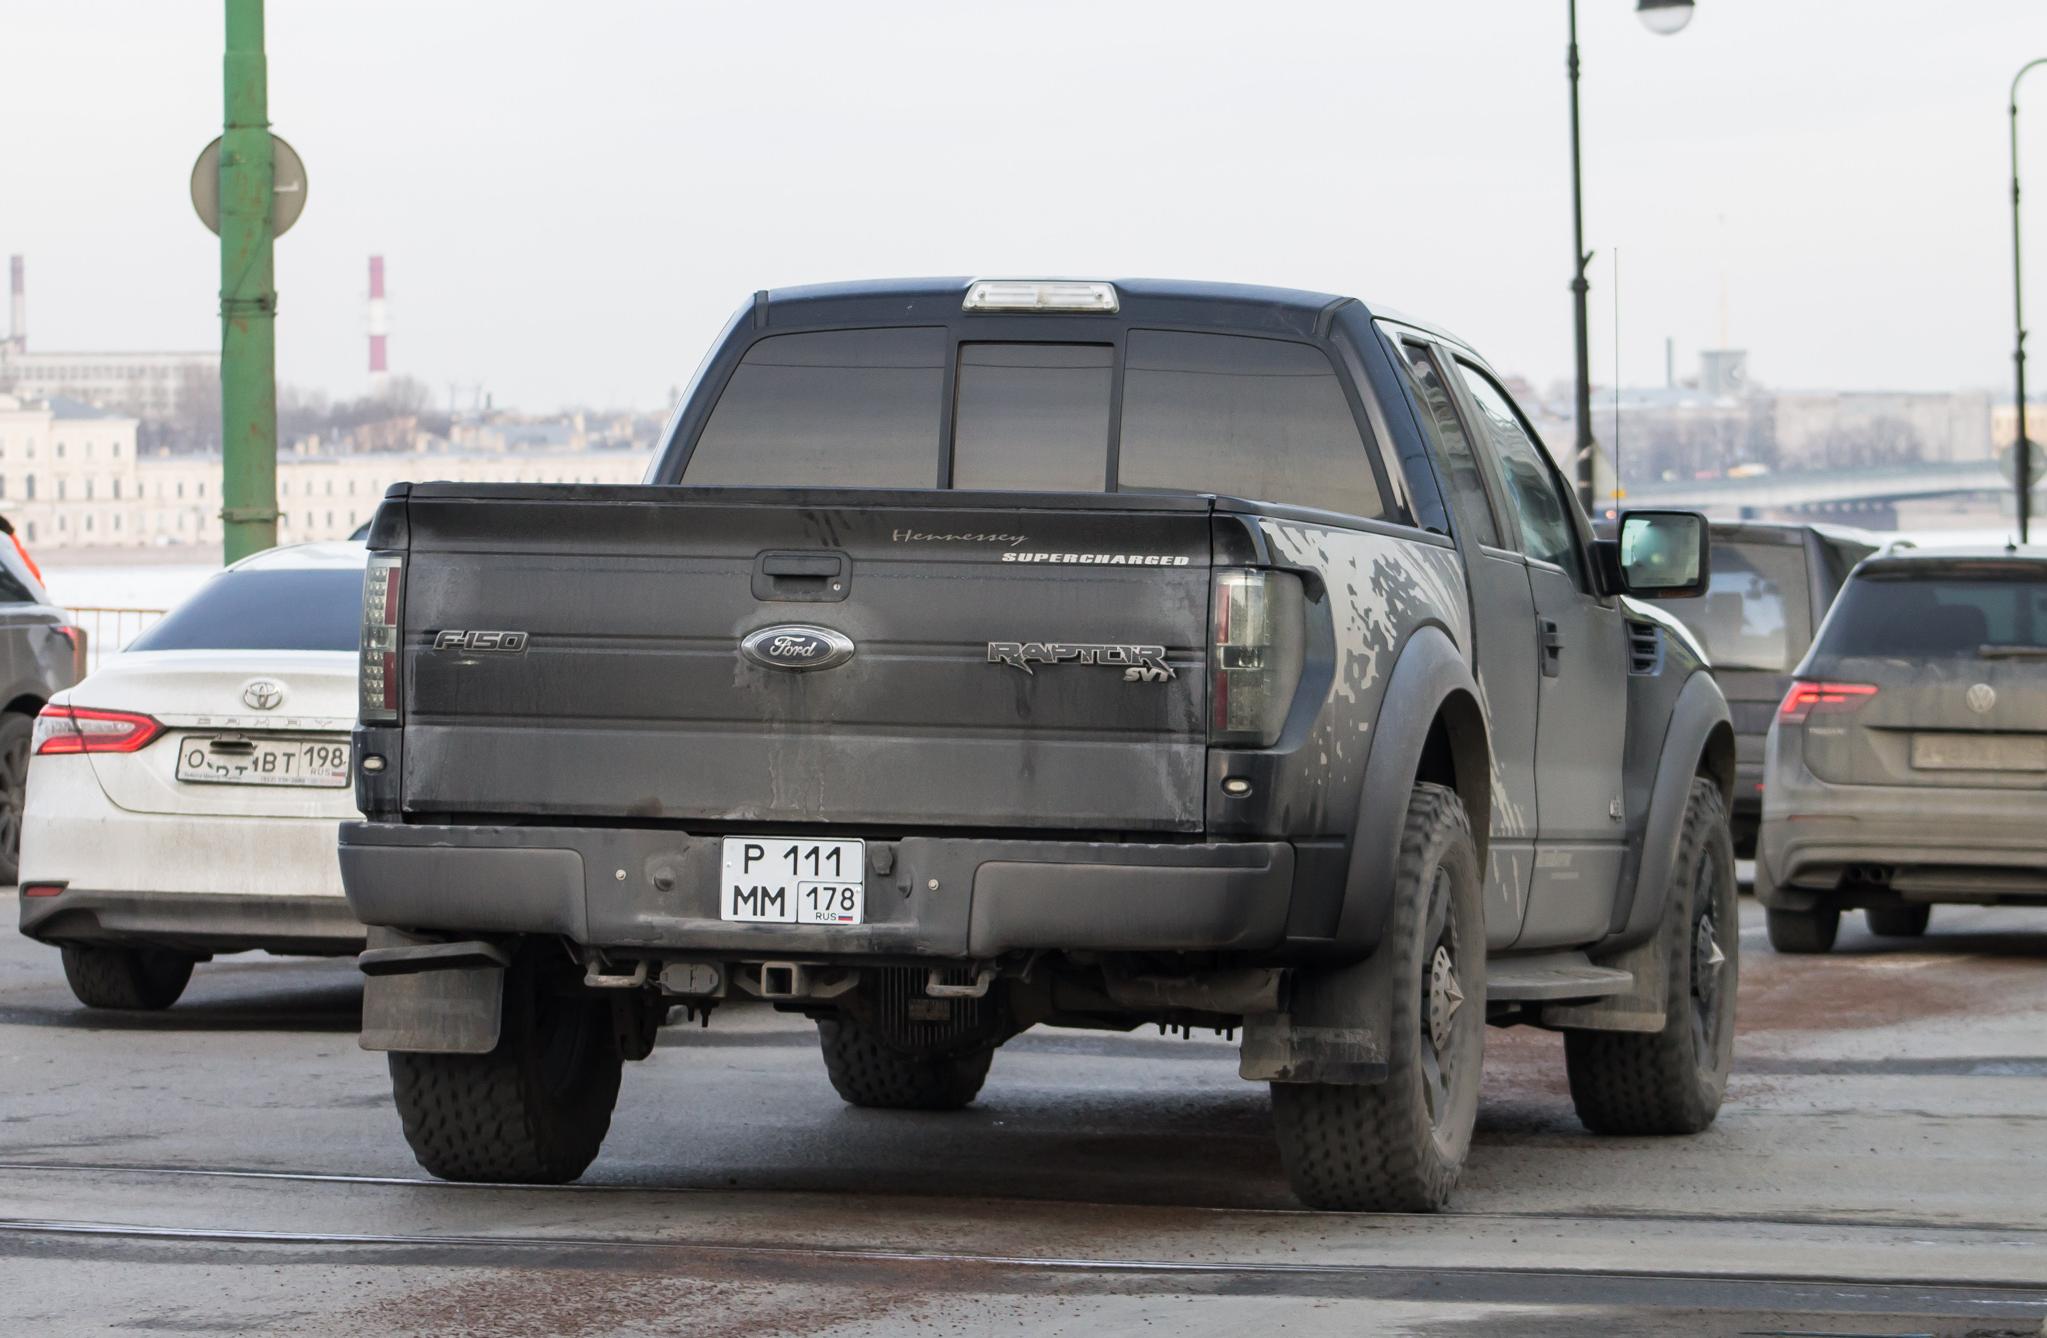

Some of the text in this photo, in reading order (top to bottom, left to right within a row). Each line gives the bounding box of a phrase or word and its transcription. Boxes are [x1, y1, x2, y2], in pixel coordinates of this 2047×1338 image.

[892, 528, 1029, 546] Hennessey
[1002, 551, 1190, 566] SUPERCHARGED
[432, 629, 529, 652] F-150
[769, 635, 818, 657] Ford
[987, 641, 1177, 679] RAPTOR
[1123, 666, 1173, 683] SVT
[303, 746, 344, 768] 198
[783, 845, 841, 877] 111
[806, 886, 855, 911] 178
[815, 912, 837, 921] RUS
